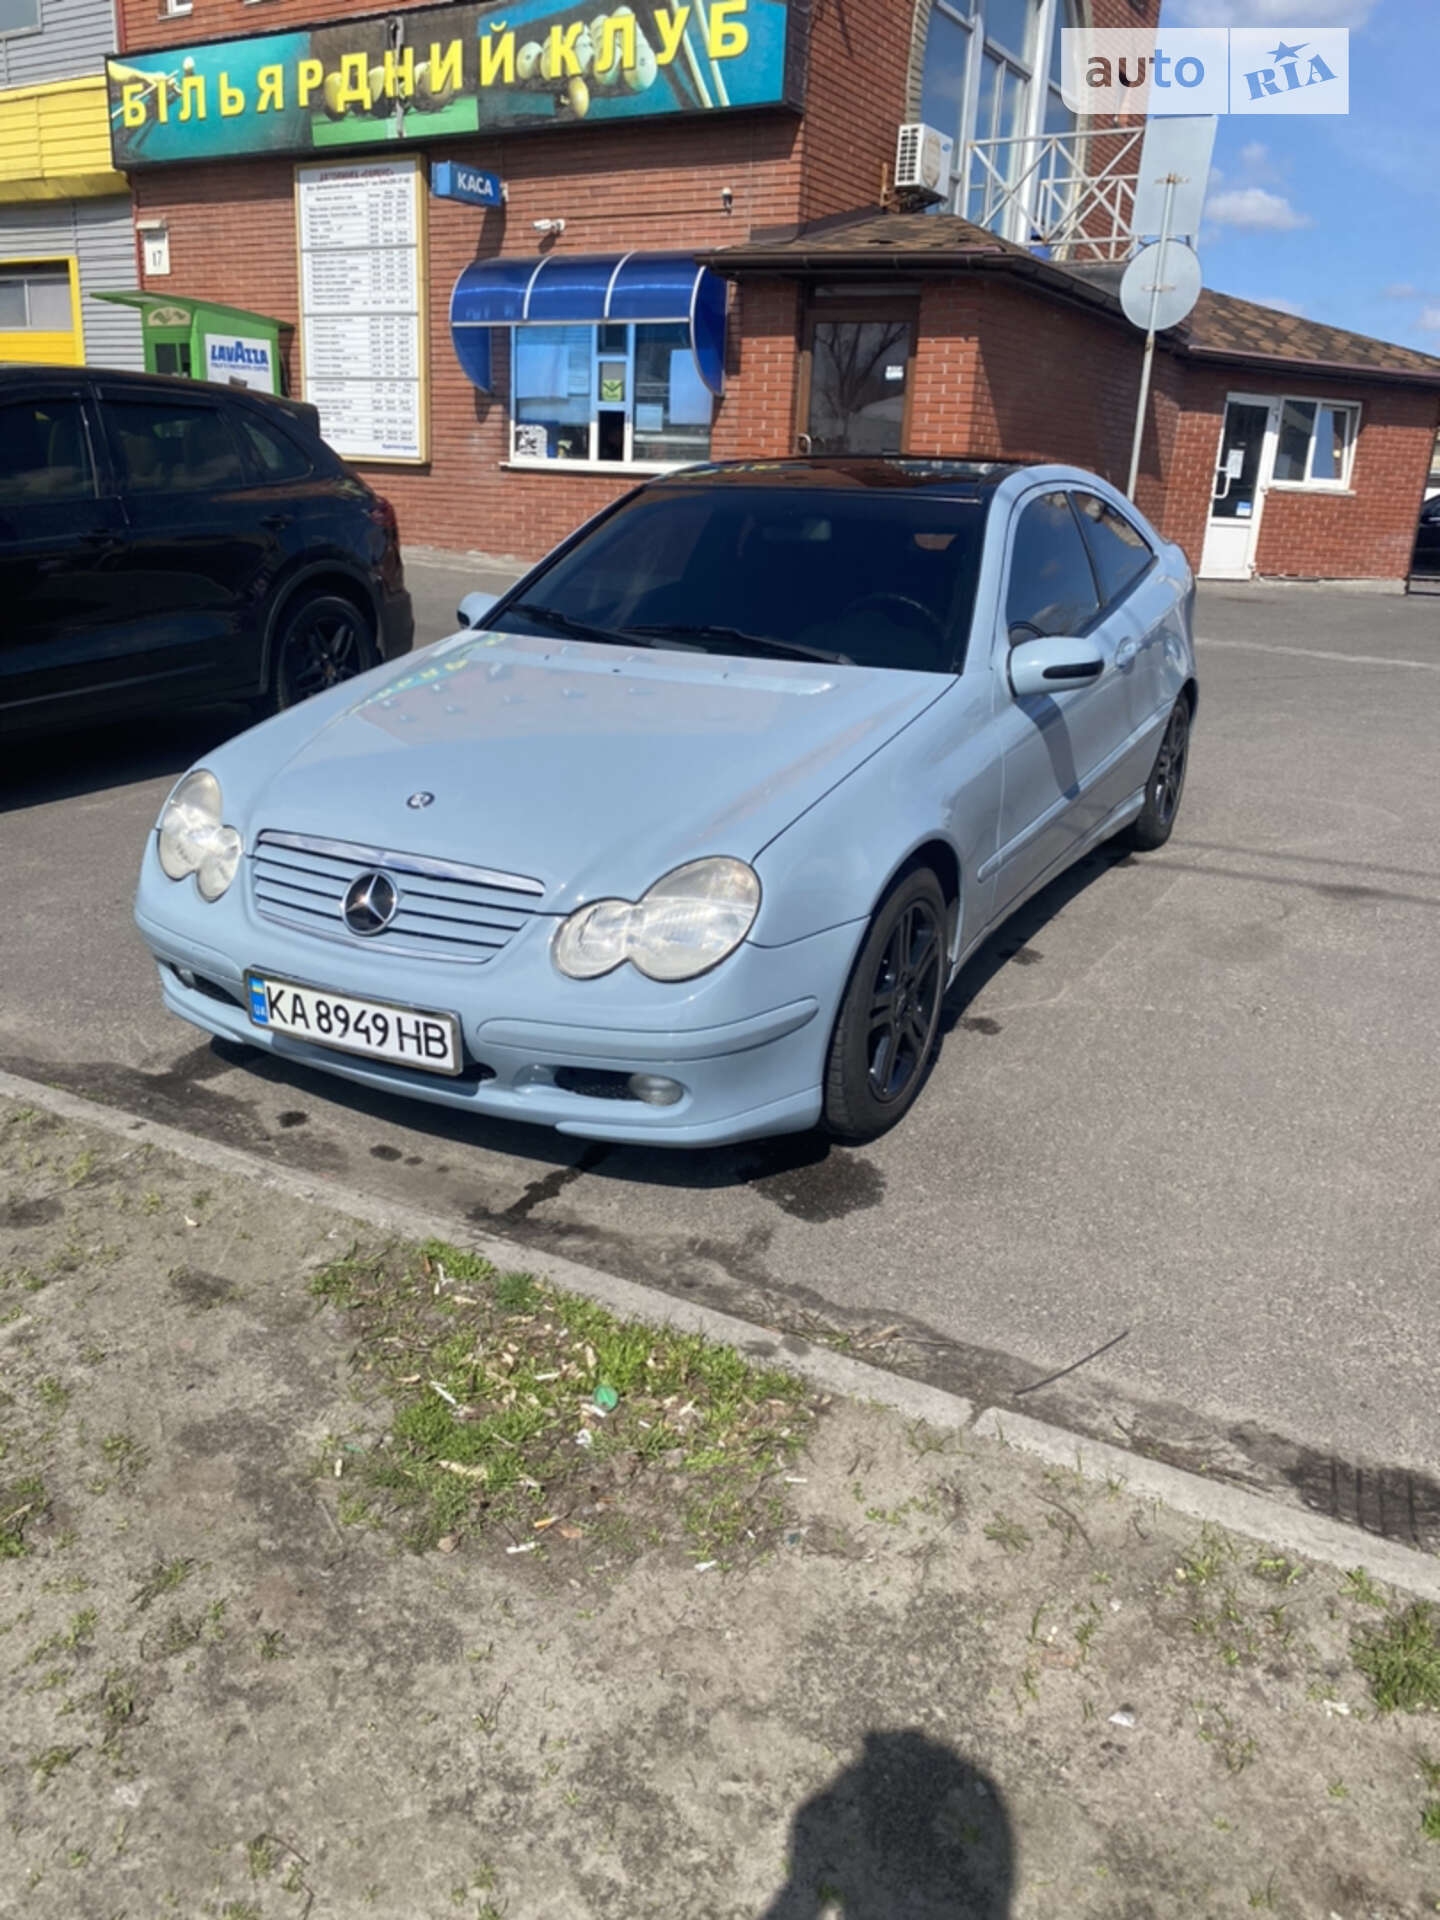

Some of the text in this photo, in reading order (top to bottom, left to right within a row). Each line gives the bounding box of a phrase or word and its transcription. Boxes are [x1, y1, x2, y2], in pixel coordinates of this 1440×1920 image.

[122, 0, 749, 128] БІЛЬЯРДНИЙ КЛУБ
[457, 171, 494, 197] КАСА
[266, 985, 449, 1060] KA 8949 HB
